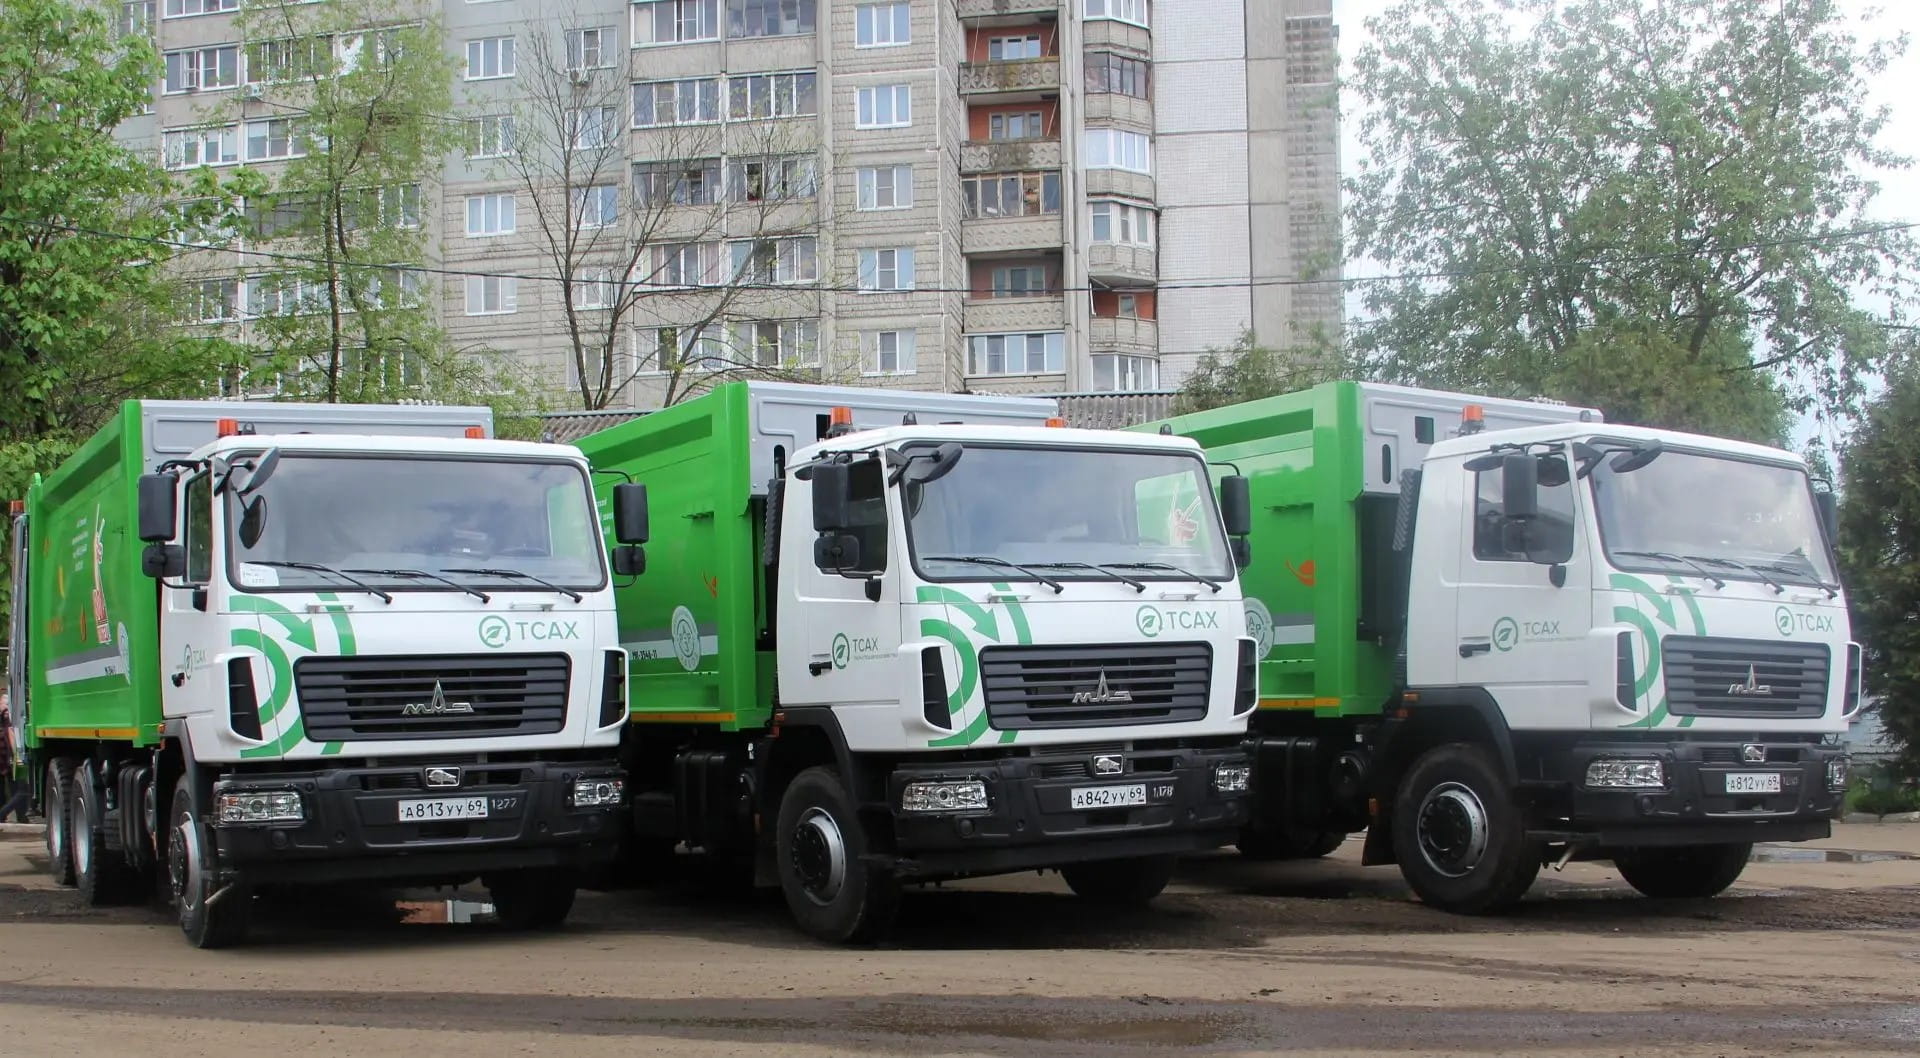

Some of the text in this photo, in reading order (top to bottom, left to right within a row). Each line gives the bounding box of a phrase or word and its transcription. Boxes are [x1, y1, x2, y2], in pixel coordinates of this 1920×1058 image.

[1166, 611, 1218, 629] ТСАХ
[1796, 613, 1834, 632] ТСАХ
[515, 621, 579, 640] ТСАХ
[1523, 621, 1560, 635] ТСАХ
[852, 638, 879, 652] ТСАХ
[1129, 787, 1142, 799] 69
[467, 800, 482, 812] 69
